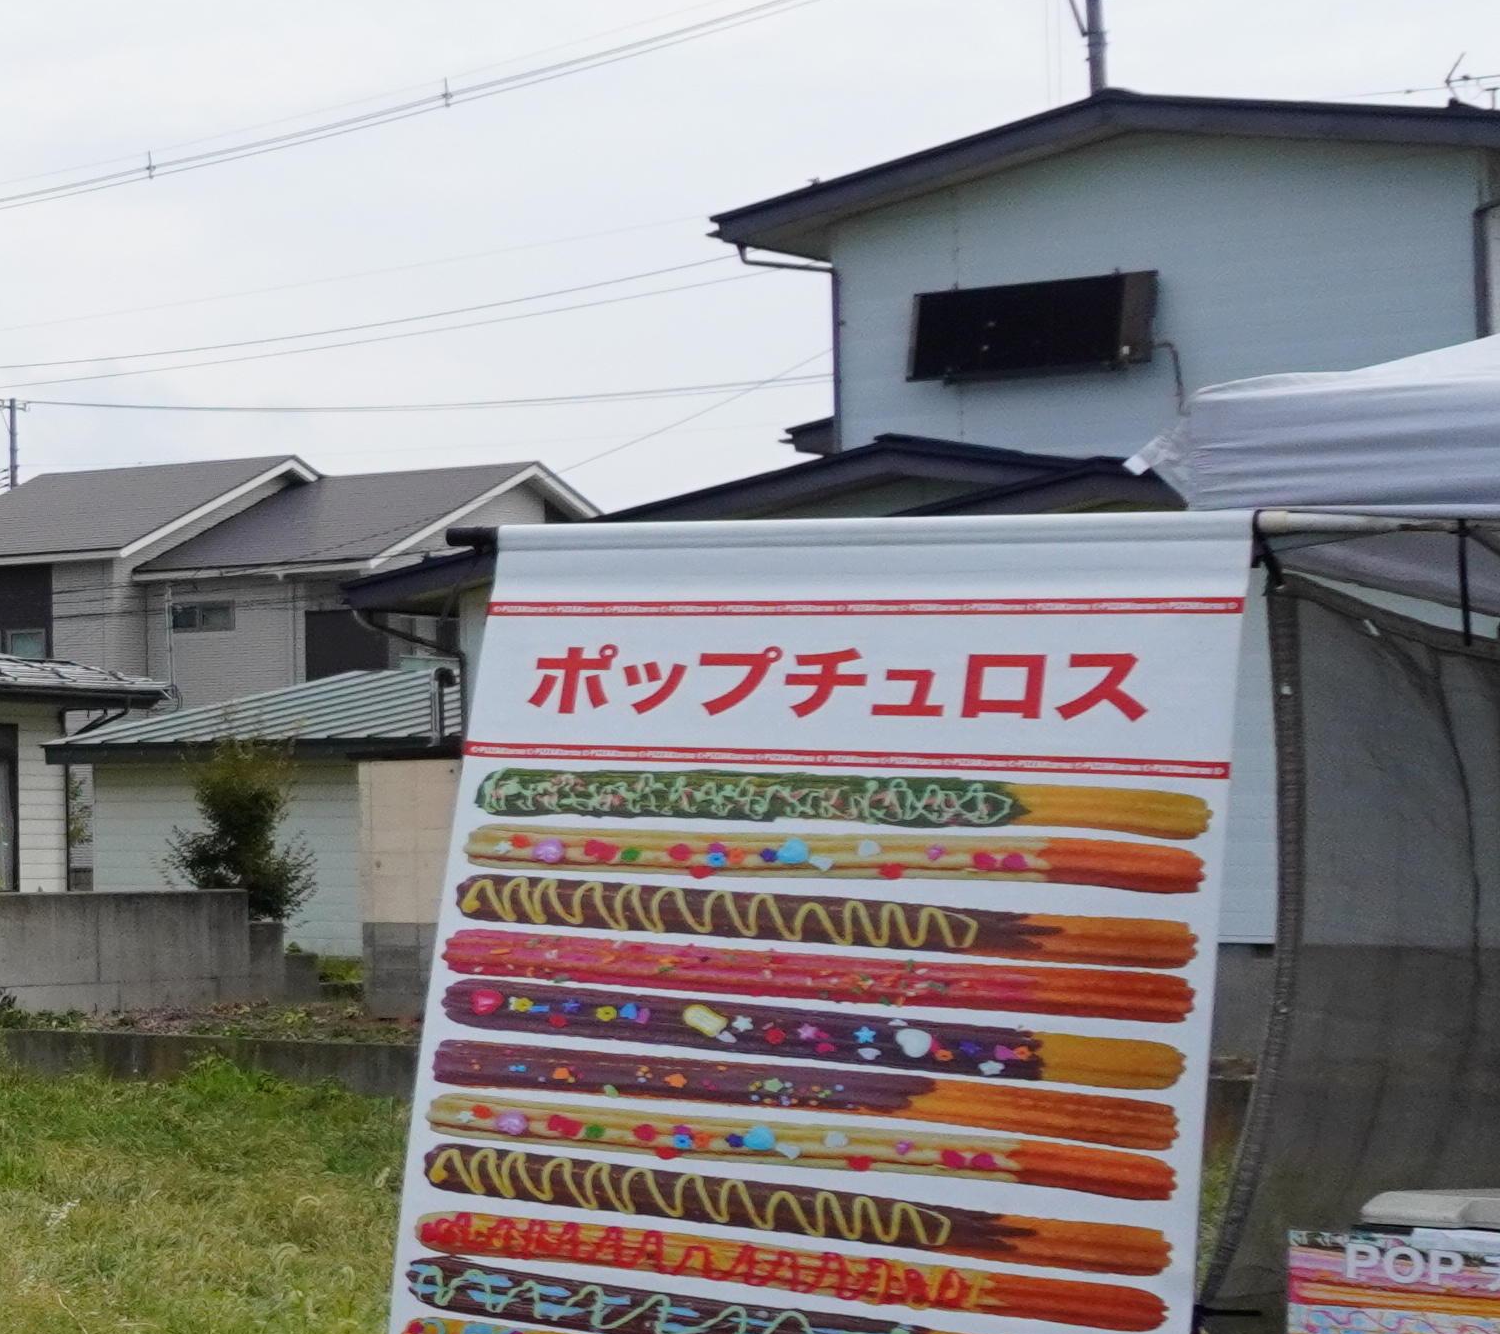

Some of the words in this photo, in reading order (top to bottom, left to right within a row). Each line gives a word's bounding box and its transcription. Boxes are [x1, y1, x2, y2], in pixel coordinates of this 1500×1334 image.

[527, 643, 1149, 722] ポップチュロス
[1345, 1241, 1465, 1286] POP
